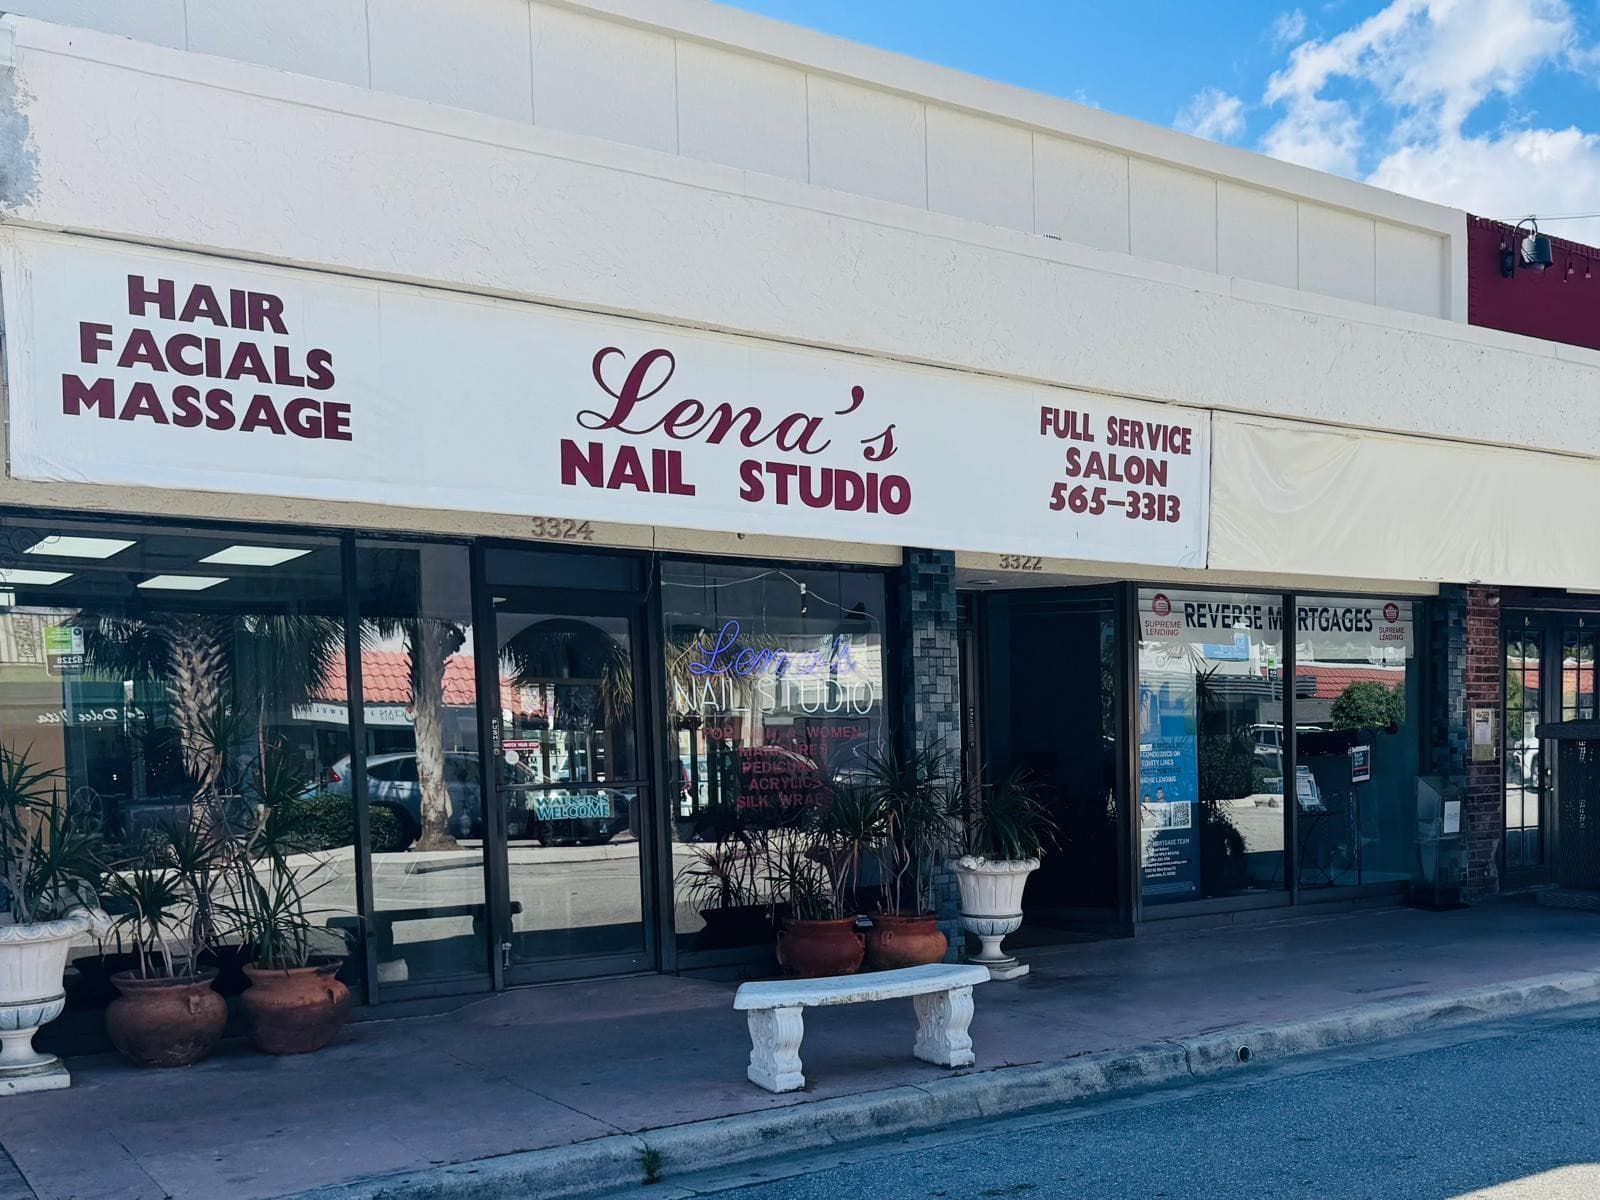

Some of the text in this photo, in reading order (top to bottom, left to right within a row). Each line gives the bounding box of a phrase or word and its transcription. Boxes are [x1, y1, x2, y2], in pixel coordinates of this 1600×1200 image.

[128, 274, 288, 335] HAIR
[79, 321, 335, 390] FACIALS
[62, 373, 352, 441] MASSAGE
[576, 346, 898, 462] Lena's
[1040, 406, 1192, 455] FULL SERVICE
[560, 439, 911, 515] NAIL STUDIO
[1065, 447, 1167, 487] SALON
[1049, 482, 1181, 523] 565-3313
[531, 517, 594, 540] 3324
[999, 554, 1042, 570] 3322
[1145, 620, 1181, 629] SUPREME
[1184, 602, 1373, 632] REVERSE MRTGAGES
[1378, 626, 1406, 634] SUPREME
[1145, 628, 1179, 637] LENDING
[673, 676, 874, 714] NAIL STUDIO
[806, 726, 863, 740] WOMEN
[535, 804, 610, 820] WELCOME
[536, 795, 609, 807] WALK-INS
[737, 795, 768, 809] SILK
